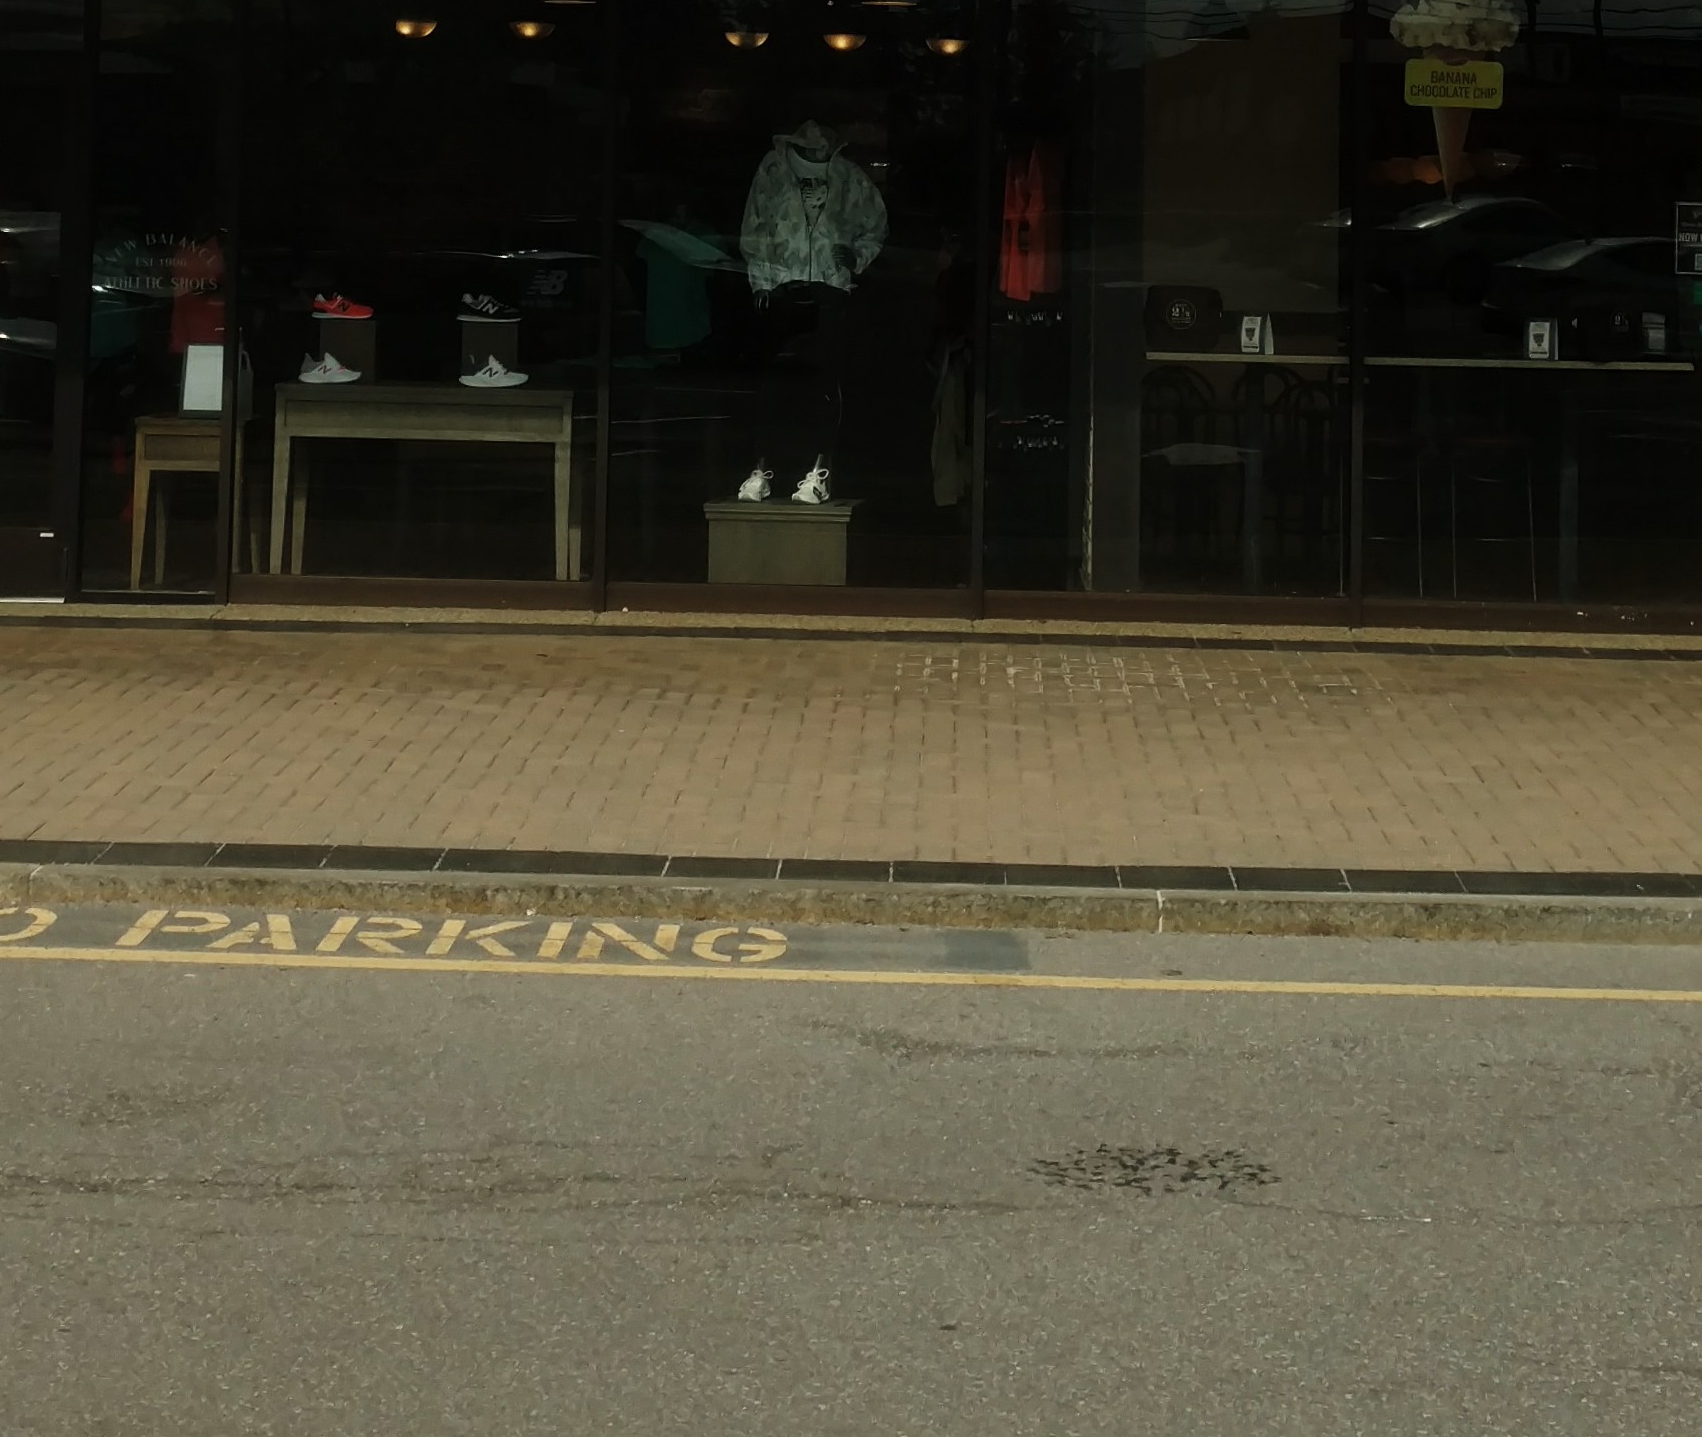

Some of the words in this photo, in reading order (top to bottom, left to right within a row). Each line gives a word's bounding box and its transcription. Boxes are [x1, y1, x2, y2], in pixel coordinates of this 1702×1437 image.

[1430, 70, 1478, 84] BANANA
[1410, 84, 1471, 99] CHOCOLATE
[1473, 87, 1498, 100] CHIP
[1678, 232, 1698, 242] NOW
[105, 239, 136, 262] NEW
[115, 909, 788, 963] PARKING
